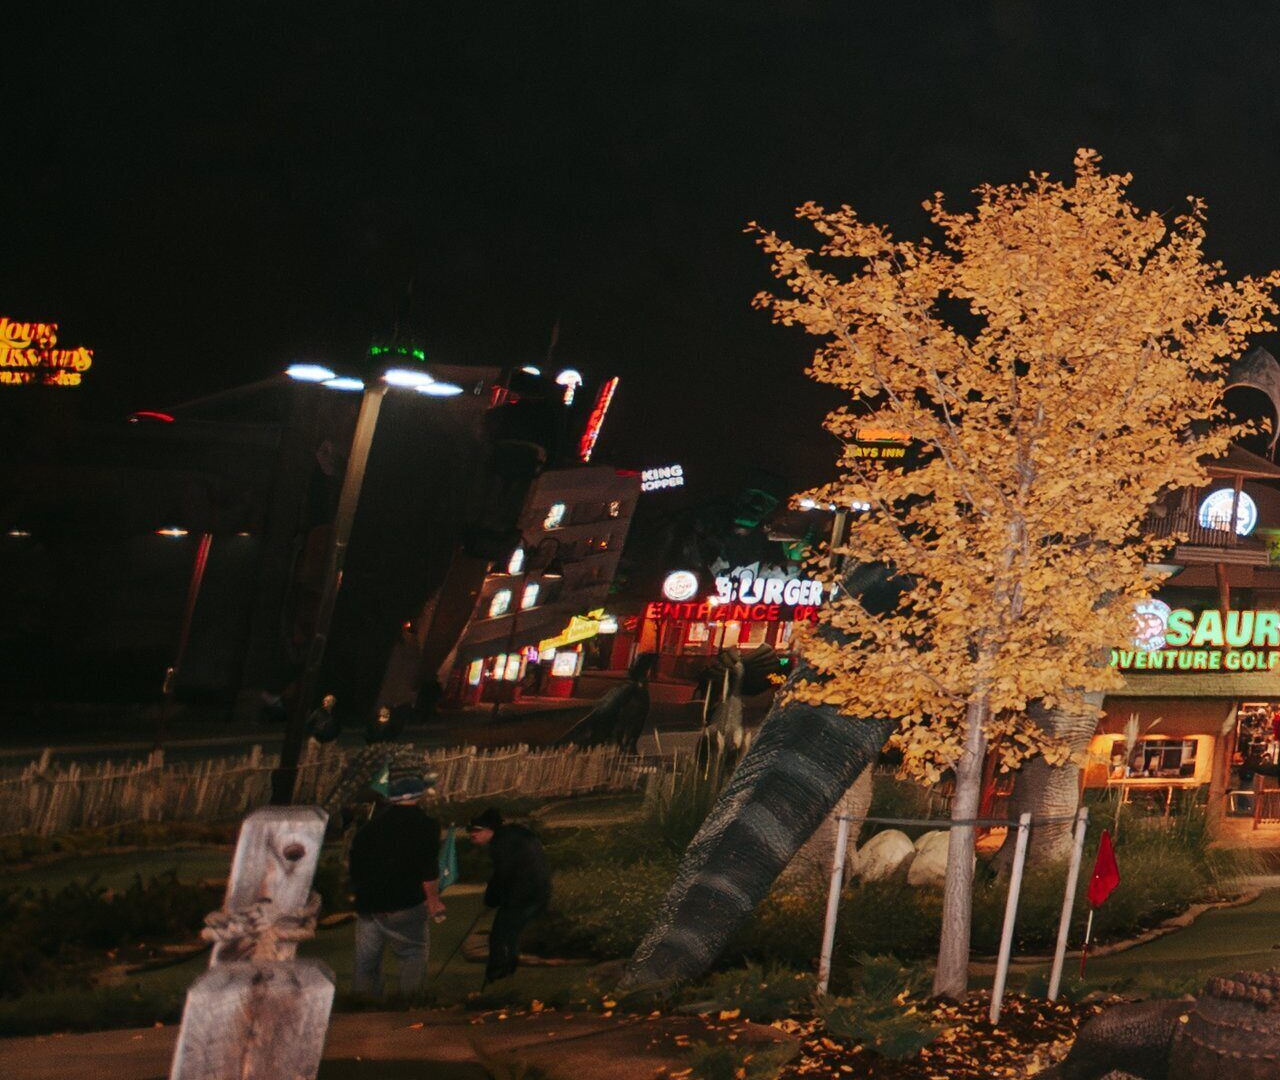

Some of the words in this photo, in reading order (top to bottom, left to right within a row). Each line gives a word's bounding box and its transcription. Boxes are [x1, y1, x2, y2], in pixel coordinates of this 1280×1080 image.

[881, 448, 906, 458] INN
[642, 465, 683, 481] KING
[646, 603, 779, 621] ENTRANCE
[1225, 650, 1280, 670] GOLF
